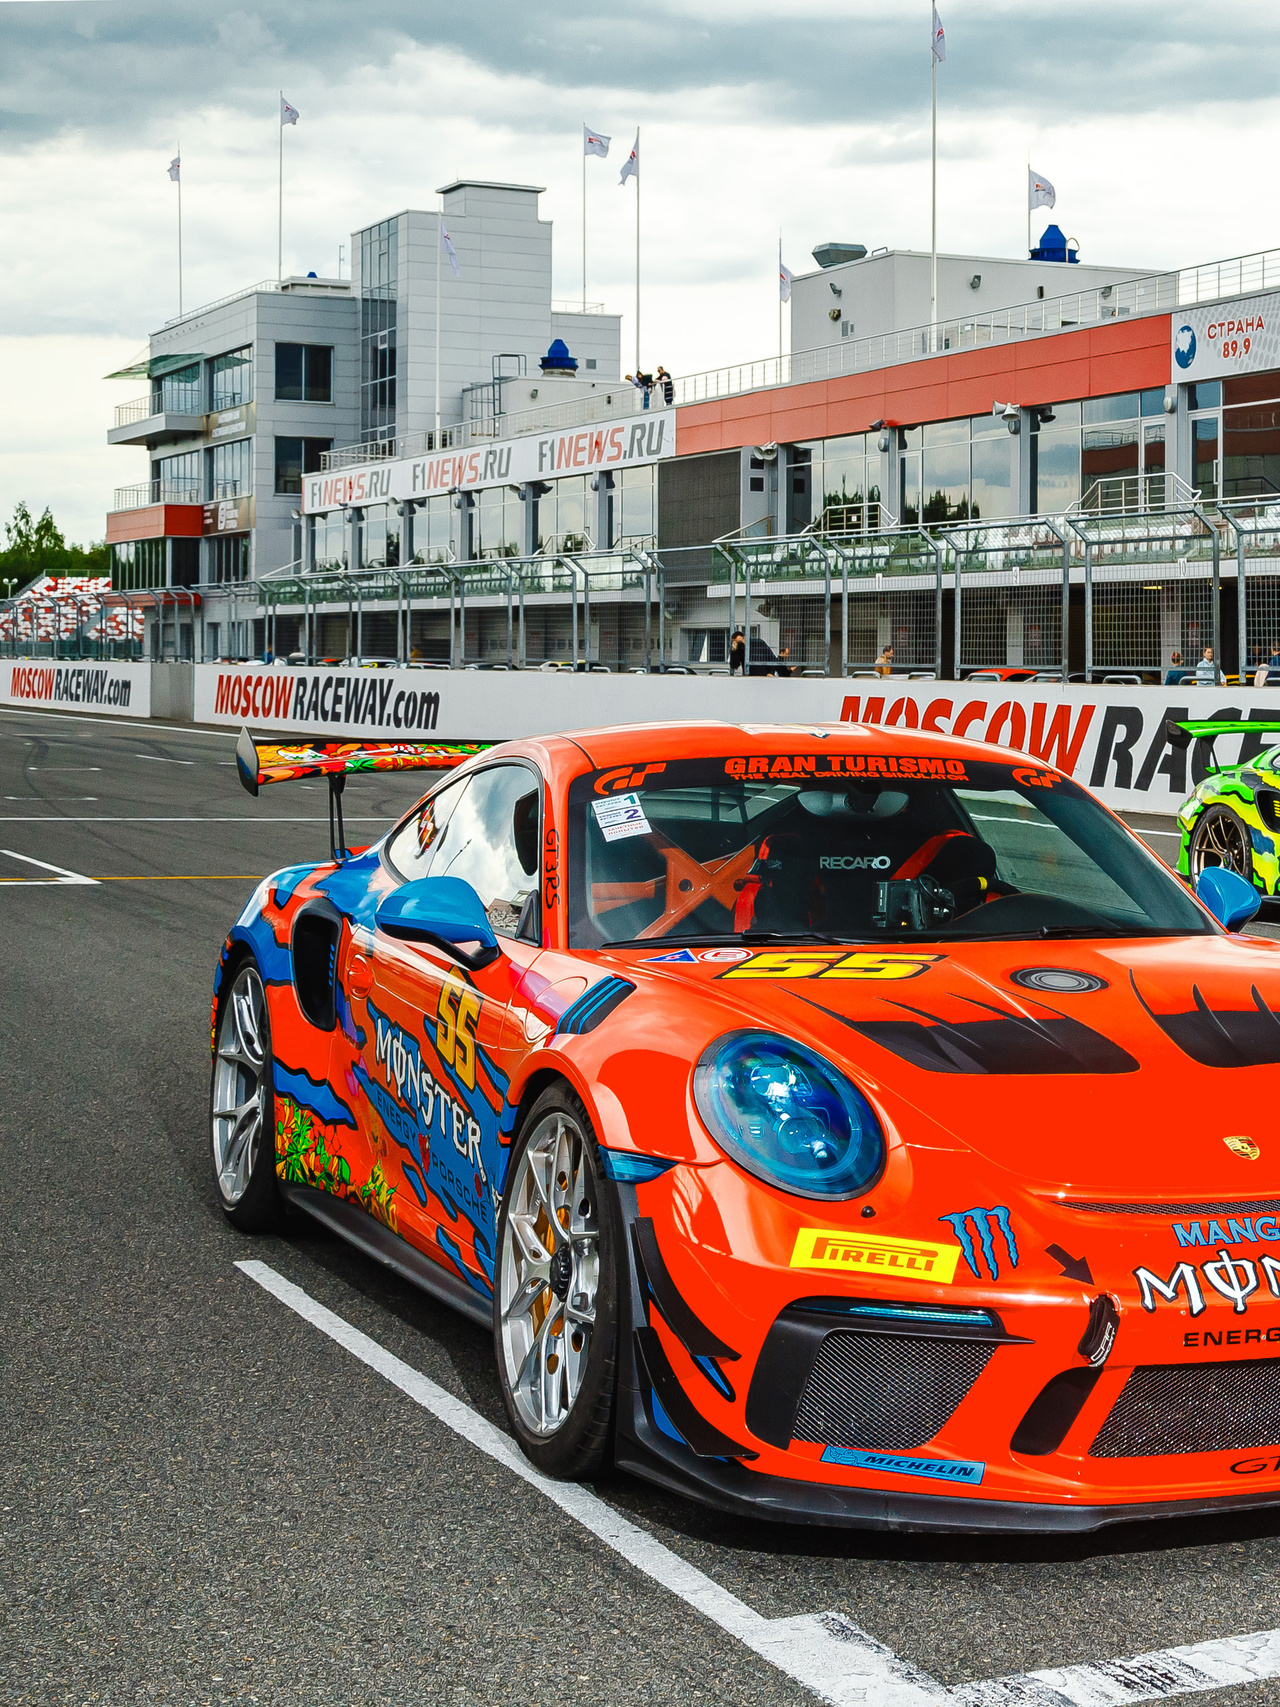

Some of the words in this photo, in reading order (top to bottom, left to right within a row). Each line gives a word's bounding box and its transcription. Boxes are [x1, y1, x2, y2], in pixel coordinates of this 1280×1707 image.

[1207, 315, 1265, 340] СТРАНА
[1222, 337, 1251, 359] 89,9
[538, 419, 665, 472] F1NEWS.RU
[412, 447, 512, 492] F1NEWS.RU
[311, 468, 392, 506] F1NEWS.RU
[725, 756, 817, 775] GRAN
[827, 756, 966, 775] TURISMO
[814, 771, 880, 779] DRIVING
[882, 771, 969, 782] SIMULATOR
[623, 794, 636, 804] 1
[624, 809, 641, 820] 2
[820, 856, 891, 869] RECARO
[712, 951, 950, 980] 55
[436, 966, 484, 1091] 55
[375, 1018, 486, 1182] MONSTER
[376, 1089, 416, 1148] ENERGY
[432, 1154, 489, 1224] PORSCHE
[811, 1236, 938, 1272] PIRELLI
[1090, 1321, 1112, 1362] CAR
[863, 1455, 975, 1477] MICHELIN
